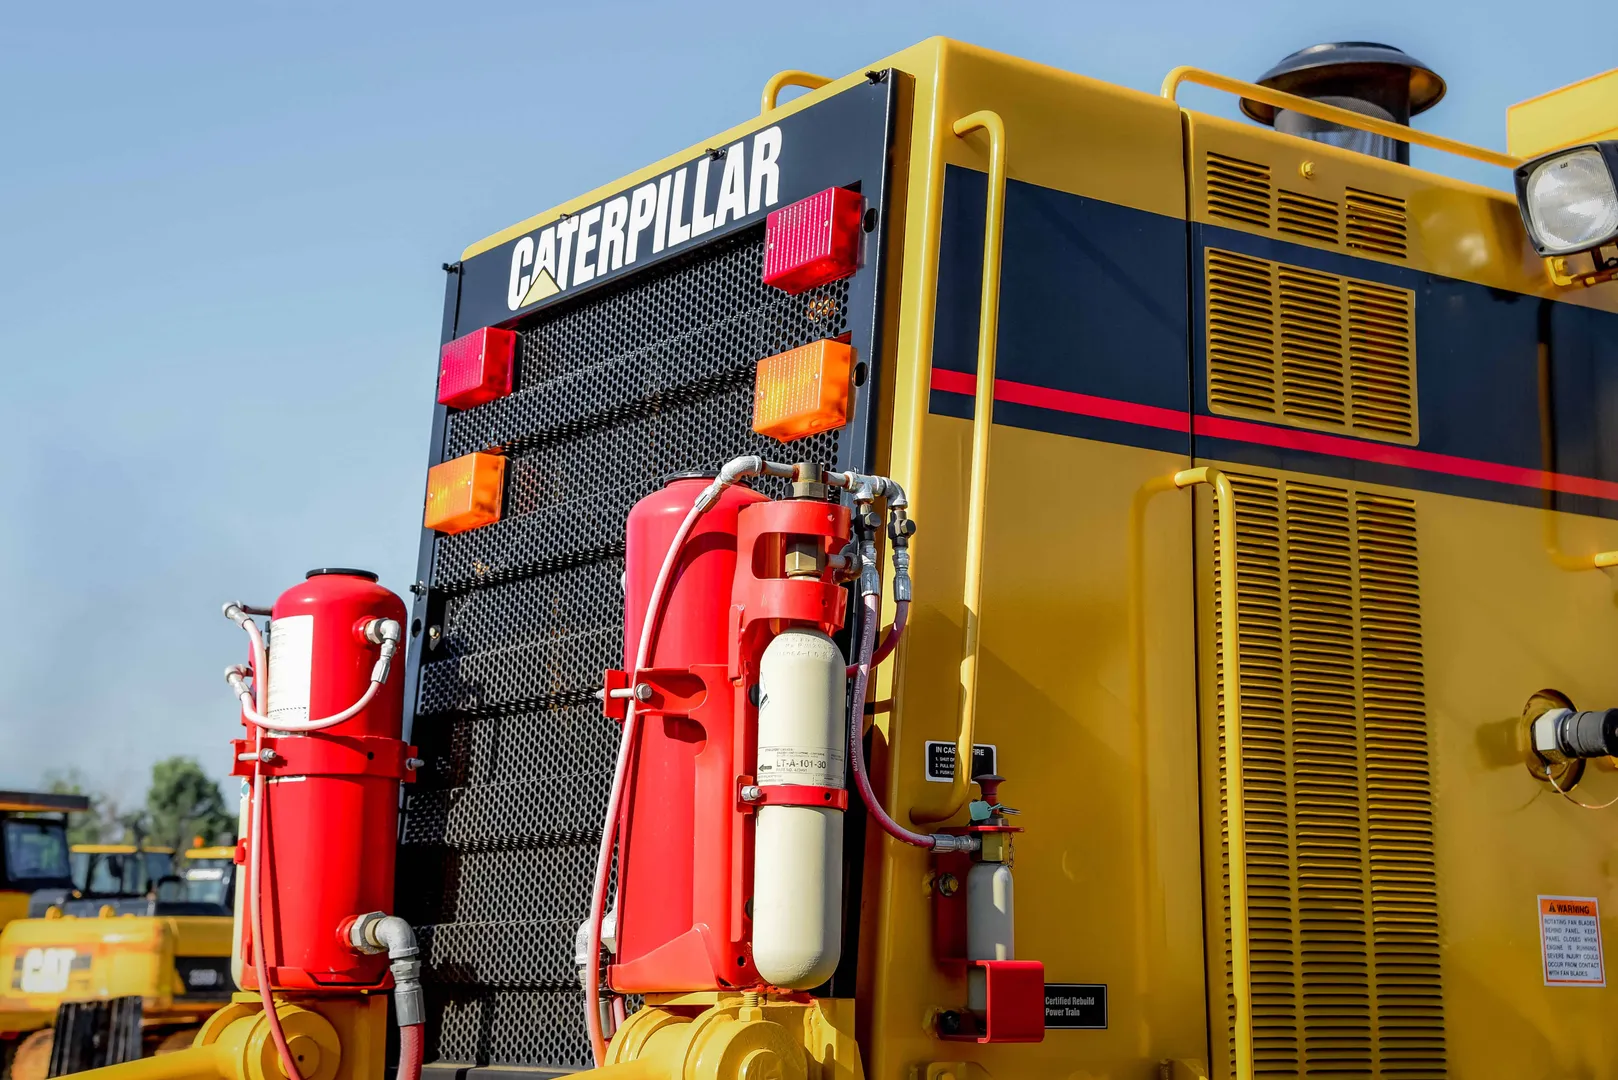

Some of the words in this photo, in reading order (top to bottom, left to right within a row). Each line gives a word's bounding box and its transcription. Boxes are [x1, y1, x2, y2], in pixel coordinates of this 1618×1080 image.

[507, 126, 783, 312] CATERPILLAR
[943, 746, 957, 755] CAS
[776, 759, 827, 769] LT-A-101-30
[1556, 904, 1590, 915] WARNING
[1045, 996, 1071, 1006] Certified
[1072, 996, 1095, 1006] Rebuild
[1045, 1007, 1065, 1017] Power
[1065, 1007, 1080, 1017] Train
